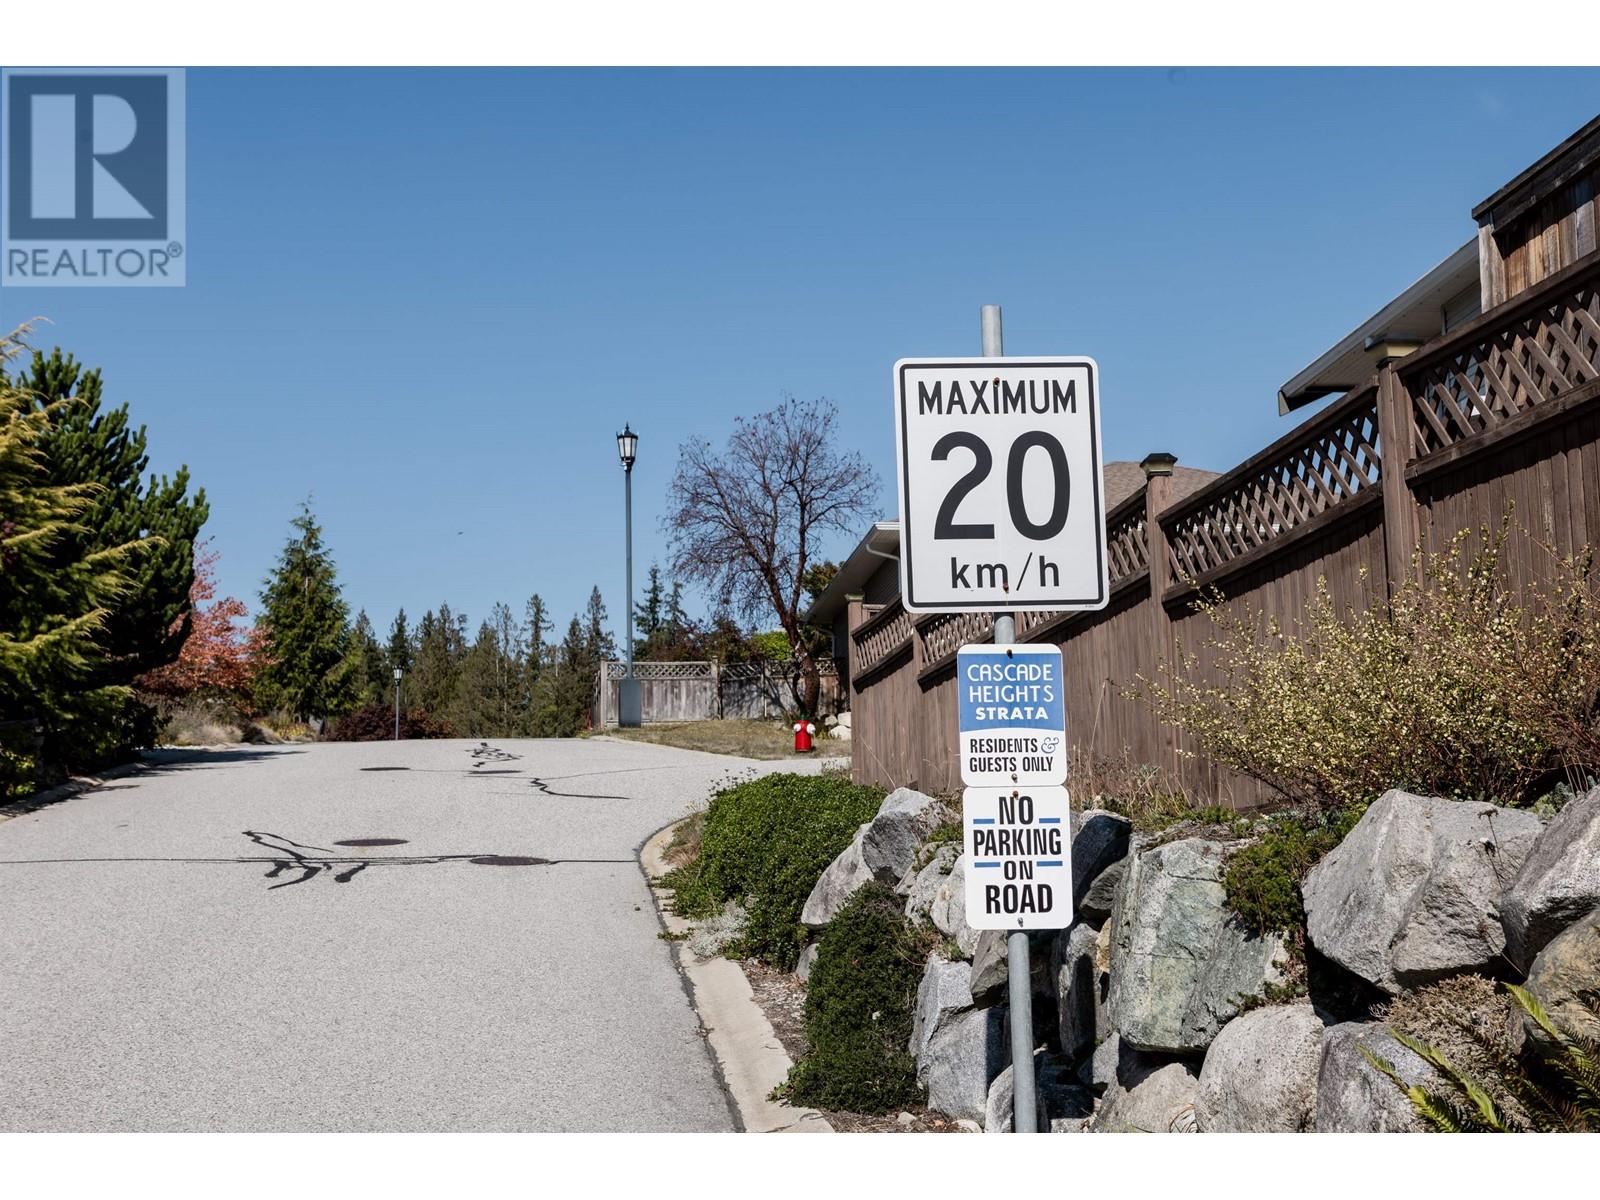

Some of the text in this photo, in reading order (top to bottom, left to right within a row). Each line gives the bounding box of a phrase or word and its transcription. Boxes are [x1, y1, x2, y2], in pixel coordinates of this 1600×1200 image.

[918, 379, 1077, 415] MAXIMUM
[930, 430, 1071, 541] 20
[951, 552, 1060, 591] km/h
[967, 663, 1053, 682] CASCADE
[969, 685, 1054, 704] HEIGHTS
[975, 706, 1049, 720] STRATA
[970, 736, 1060, 754] RESIDENTS &
[969, 756, 1054, 773] GUESTS ONLY
[999, 795, 1034, 826] NO
[973, 827, 1062, 857] PARKING
[1003, 859, 1034, 881] ON
[985, 883, 1053, 914] ROAD
